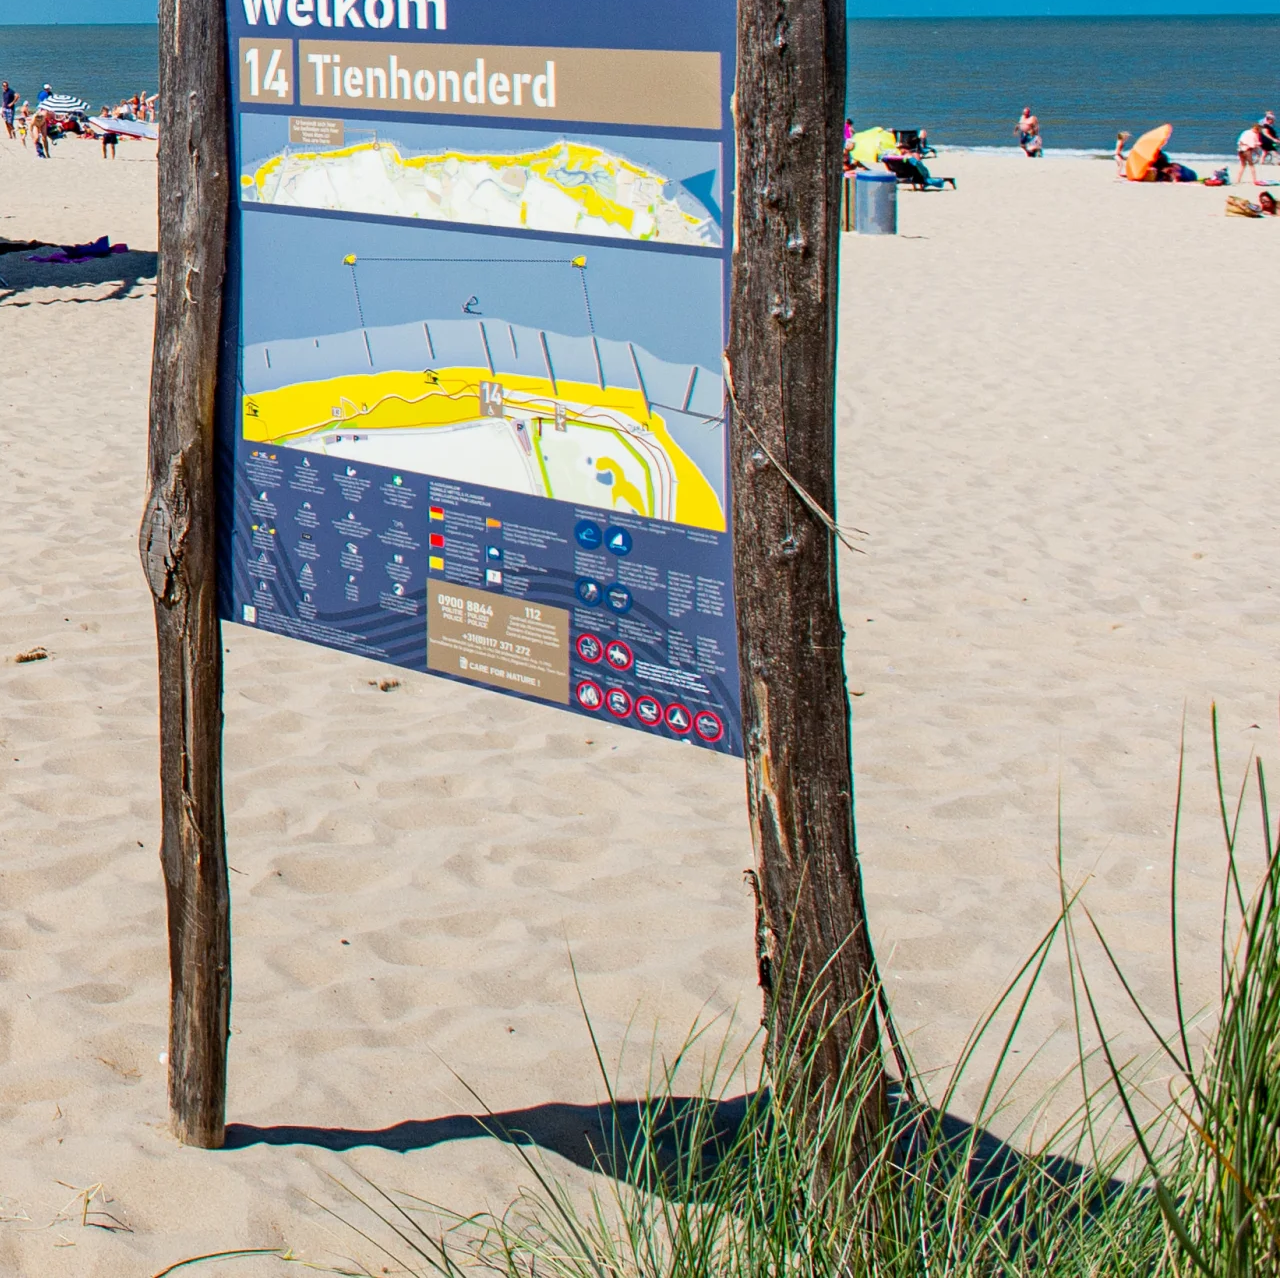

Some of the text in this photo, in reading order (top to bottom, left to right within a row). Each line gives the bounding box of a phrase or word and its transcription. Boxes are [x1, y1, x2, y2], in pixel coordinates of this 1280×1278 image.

[244, 47, 290, 99] 14
[307, 53, 557, 109] Tienhonderd
[481, 381, 501, 406] 14
[437, 593, 464, 609] 0900
[466, 601, 494, 617] 8844
[524, 606, 542, 621] 112
[499, 641, 514, 652] 371
[515, 645, 532, 657] 272
[469, 662, 489, 675] CARE
[490, 666, 506, 678] FOR
[506, 670, 537, 688] NATURE
